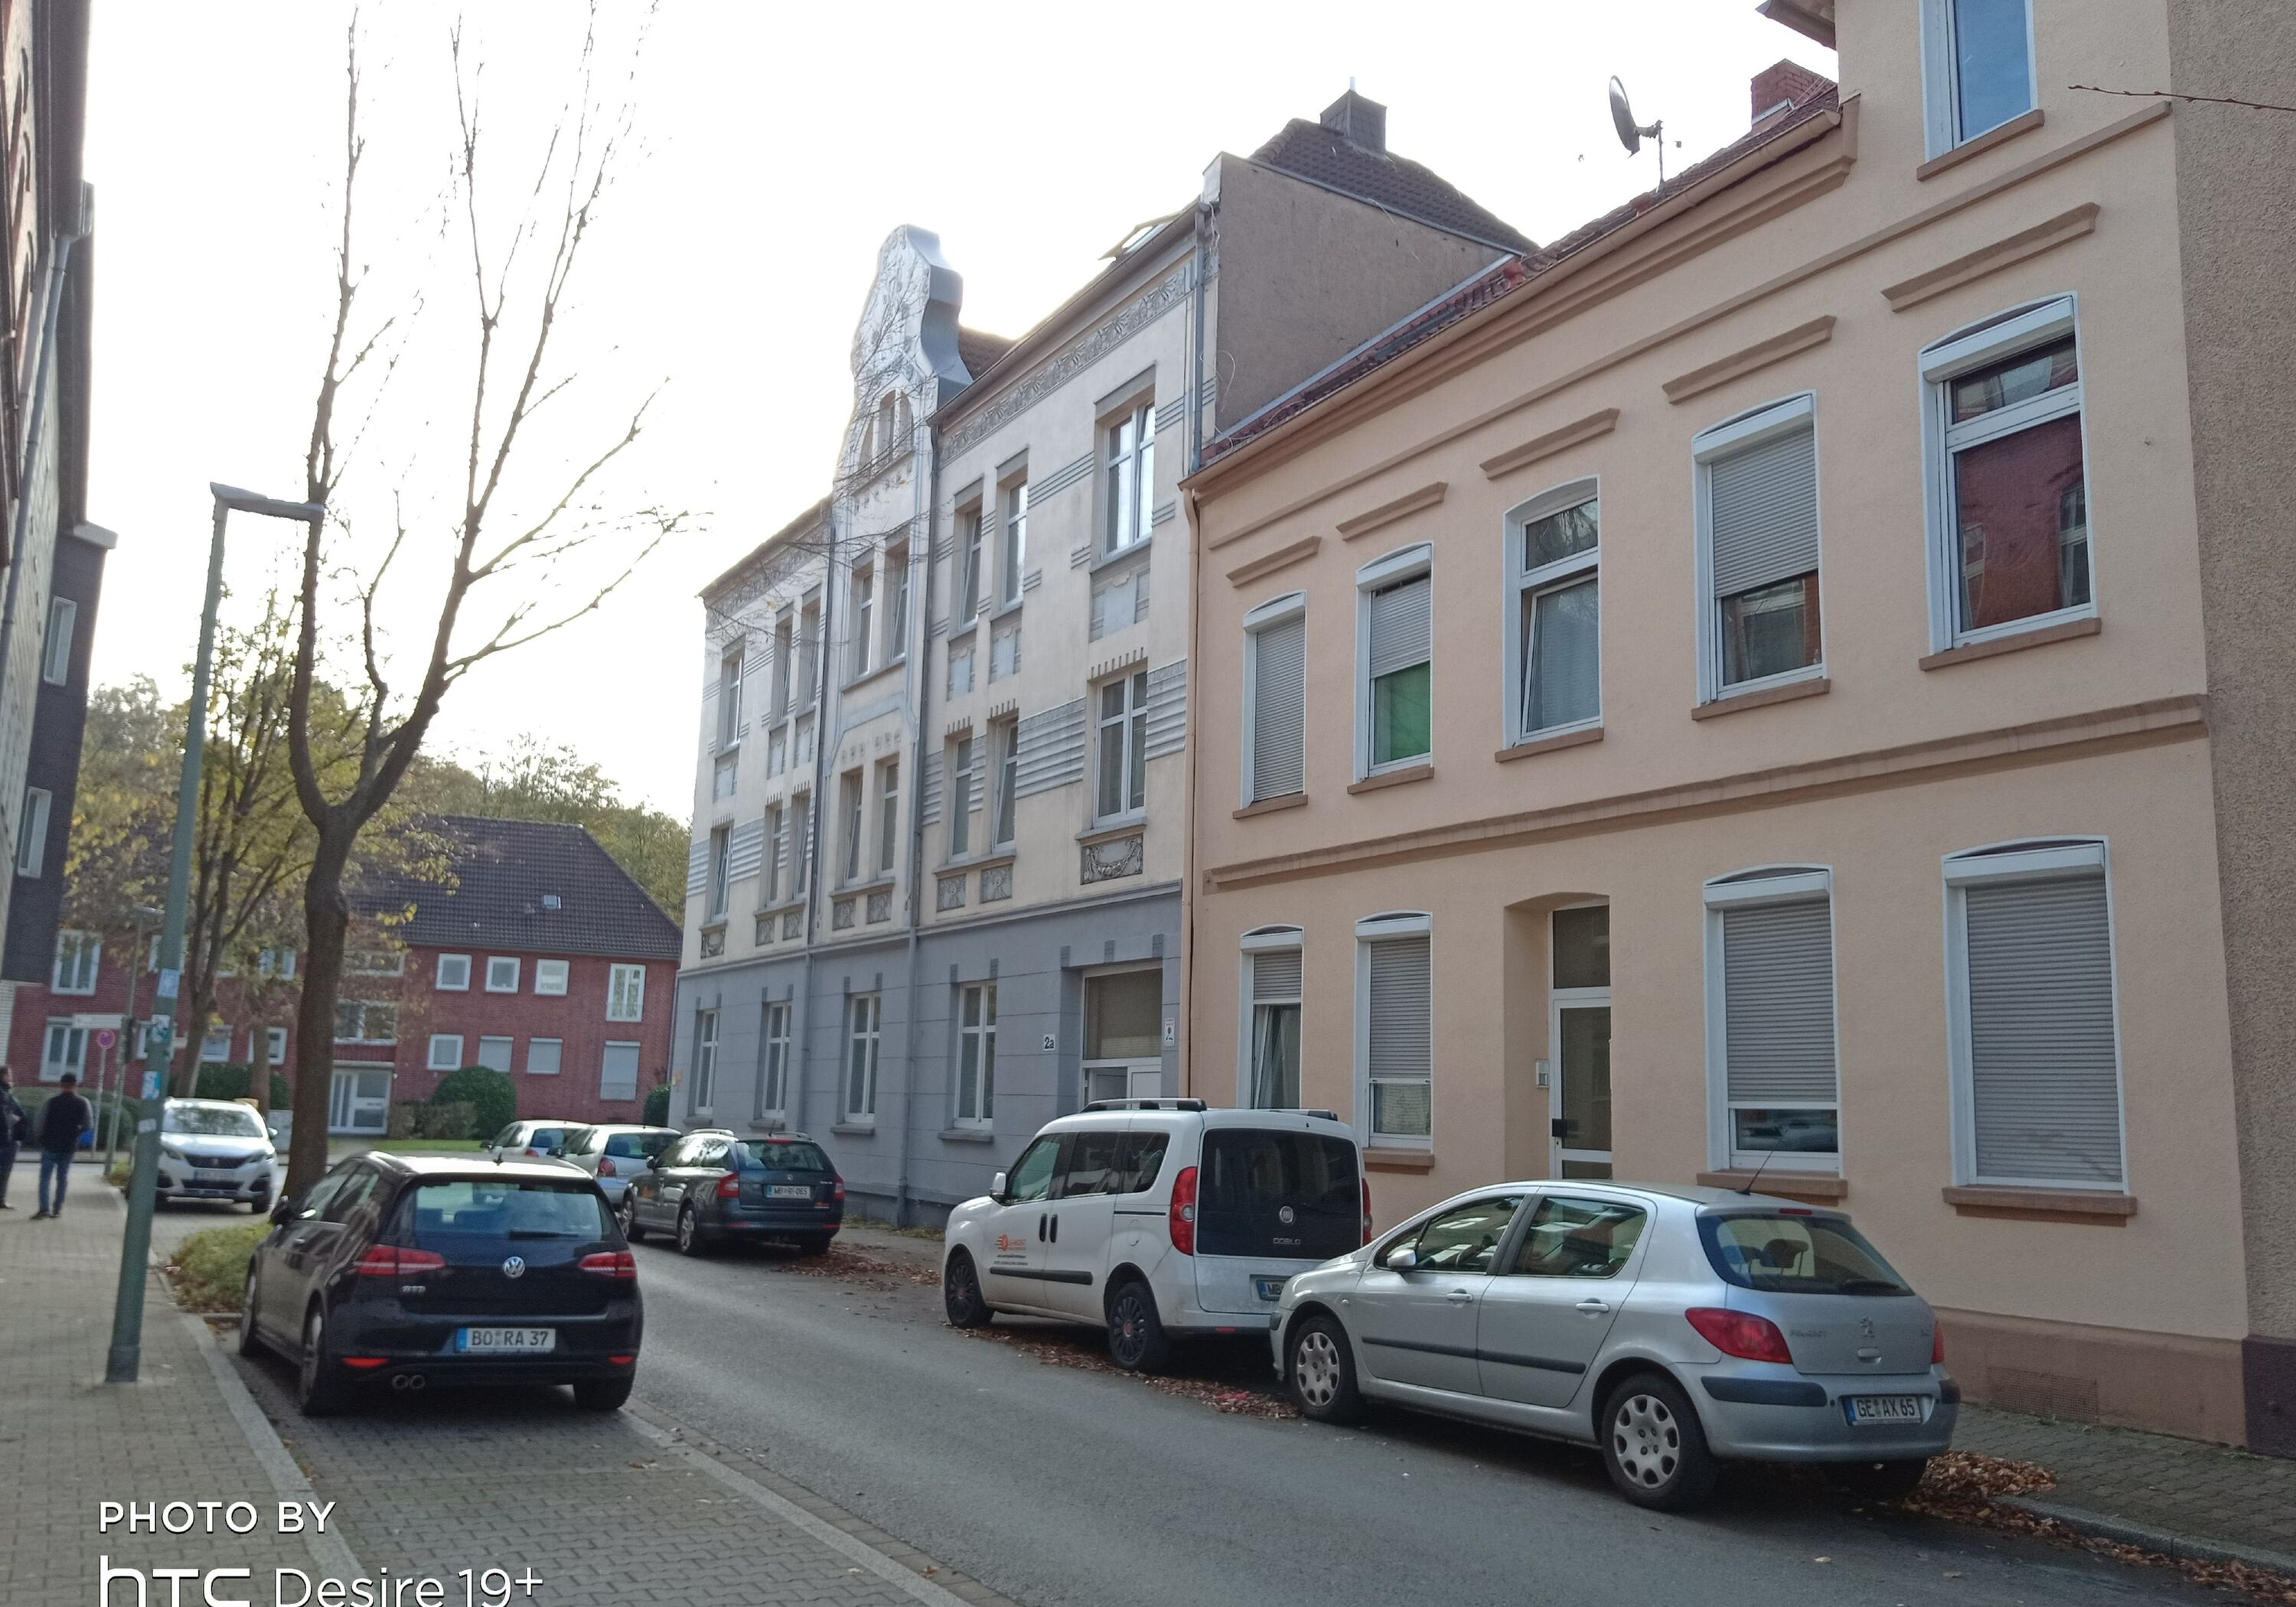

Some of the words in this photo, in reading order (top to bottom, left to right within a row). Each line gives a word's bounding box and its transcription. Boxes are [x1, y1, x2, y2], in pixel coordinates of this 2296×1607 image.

[1044, 1036, 1055, 1049] 2a
[471, 1331, 493, 1345] BO
[504, 1331, 524, 1345] RA
[530, 1331, 549, 1345] 37
[1857, 1400, 1875, 1417] GE
[1882, 1399, 1899, 1416] AX
[1900, 1398, 1915, 1416] 65
